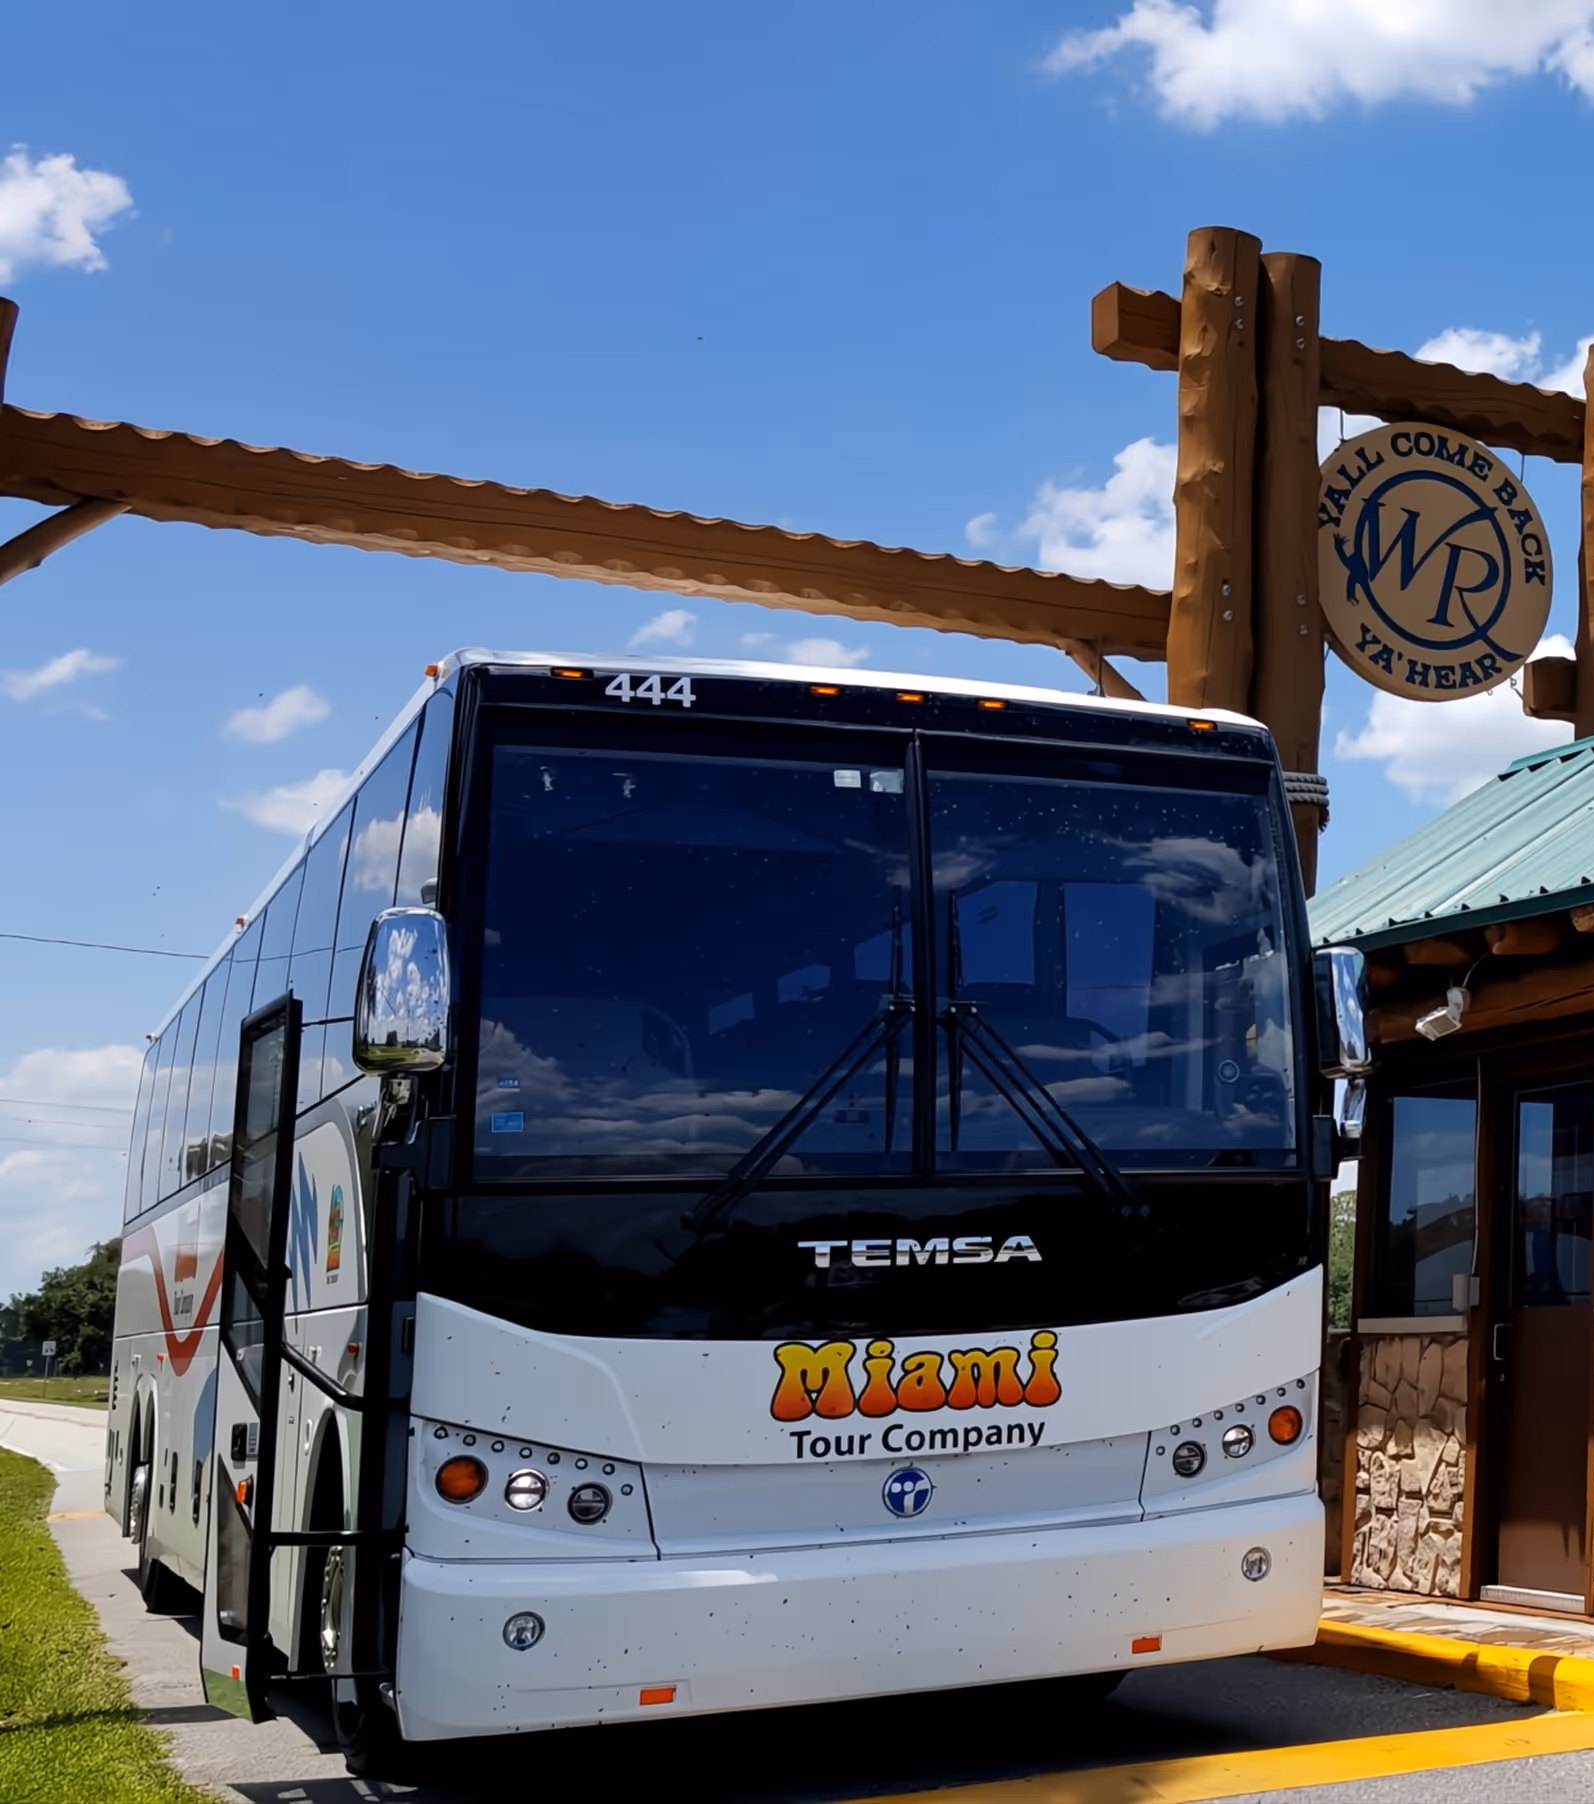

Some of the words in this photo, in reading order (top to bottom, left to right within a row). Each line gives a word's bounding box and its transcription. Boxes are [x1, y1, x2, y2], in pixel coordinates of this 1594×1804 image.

[1390, 431, 1493, 482] COME
[1493, 478, 1546, 587] BACK
[1361, 497, 1526, 662] WR
[1405, 652, 1503, 689] HEAR
[605, 673, 696, 708] 444
[797, 1235, 1043, 1268] TEMSA
[770, 1330, 1062, 1422] Miami
[789, 1429, 872, 1459] Tour
[881, 1421, 1046, 1452] Company
